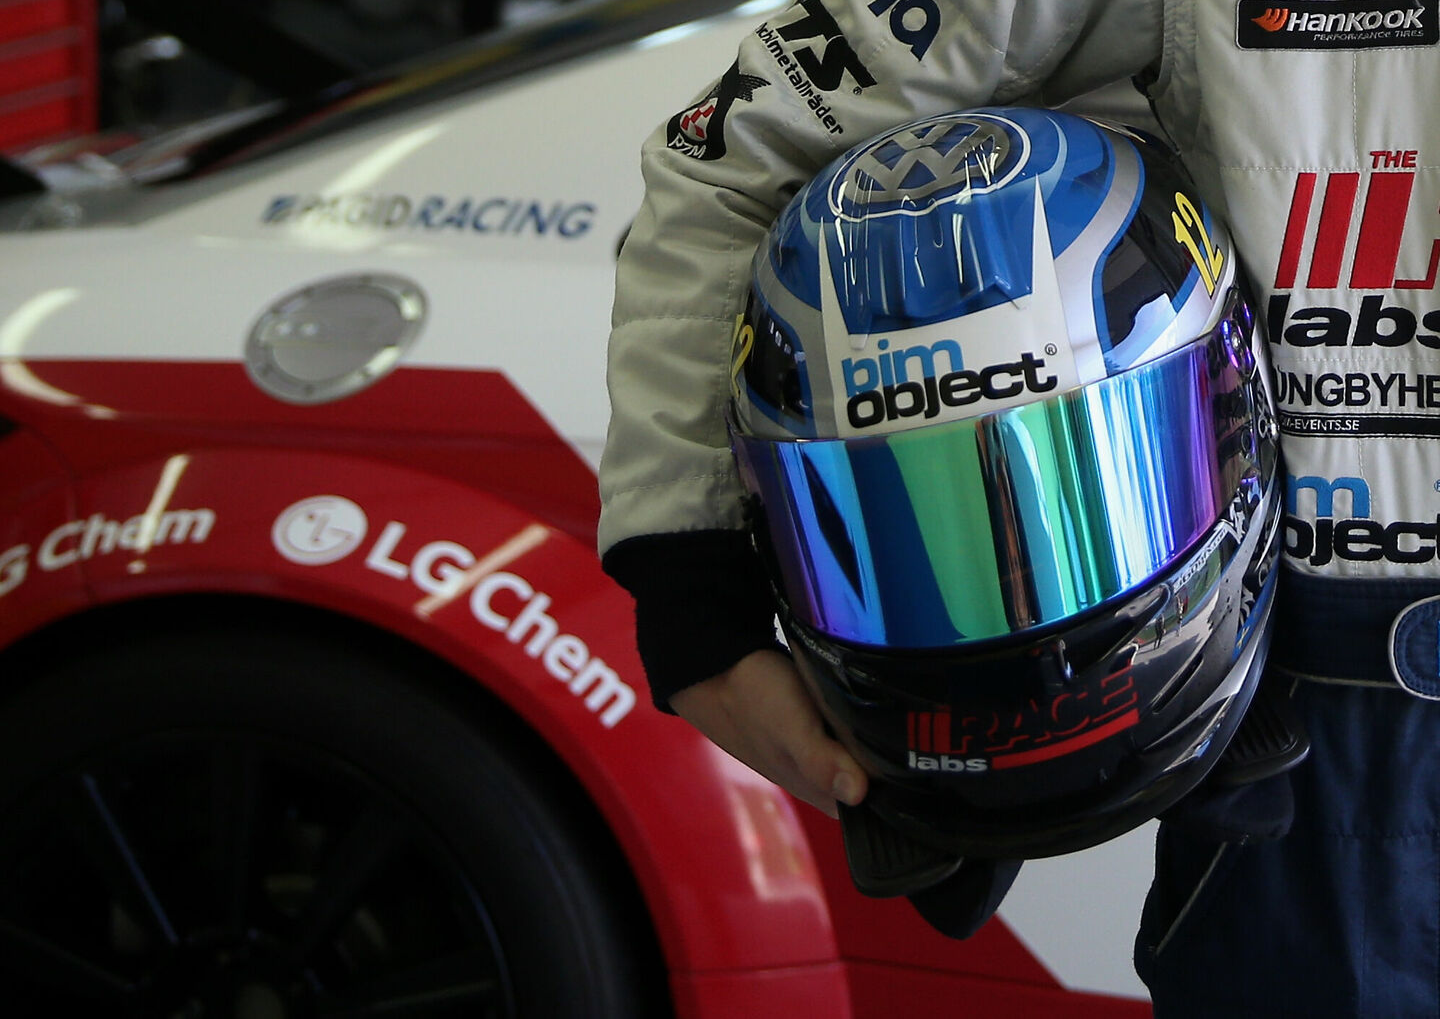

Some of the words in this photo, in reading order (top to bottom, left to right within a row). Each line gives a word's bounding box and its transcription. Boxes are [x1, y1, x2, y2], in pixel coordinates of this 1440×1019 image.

[1313, 31, 1391, 42] PERFORMANCE
[1394, 29, 1424, 38] TIRES
[1369, 150, 1418, 169] THE
[1171, 191, 1225, 297] 12
[847, 352, 1058, 429] object
[37, 509, 216, 571] Chem
[365, 520, 478, 600] LG
[470, 571, 637, 729] Chem
[906, 750, 989, 773] labs
